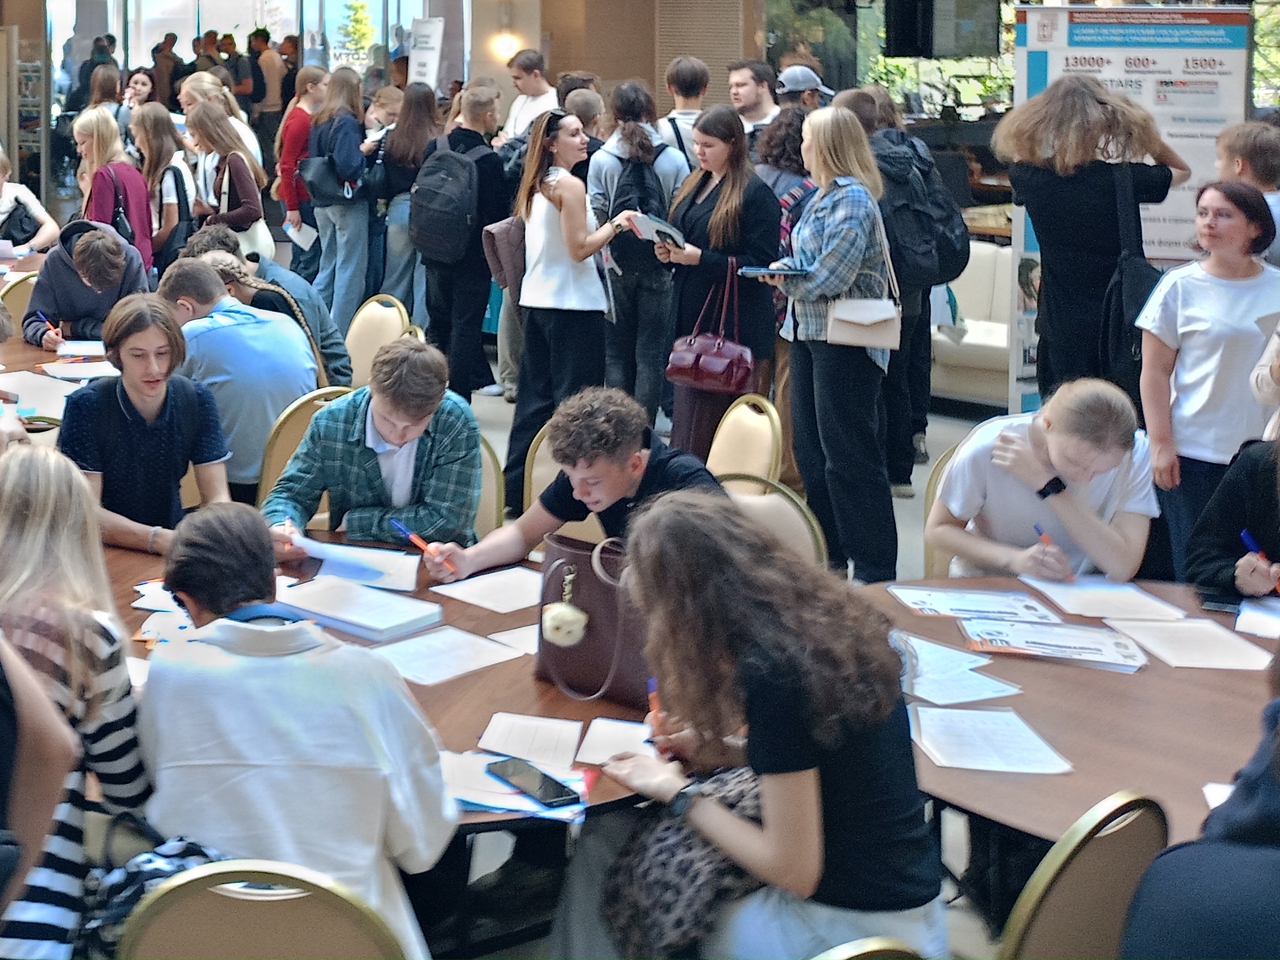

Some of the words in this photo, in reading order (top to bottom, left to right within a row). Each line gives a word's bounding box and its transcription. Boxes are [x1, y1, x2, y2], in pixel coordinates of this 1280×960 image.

[1064, 56, 1113, 68] 13000+
[1125, 56, 1159, 68] 600+
[1184, 57, 1226, 69] 1500+
[1102, 79, 1143, 89] STARS
